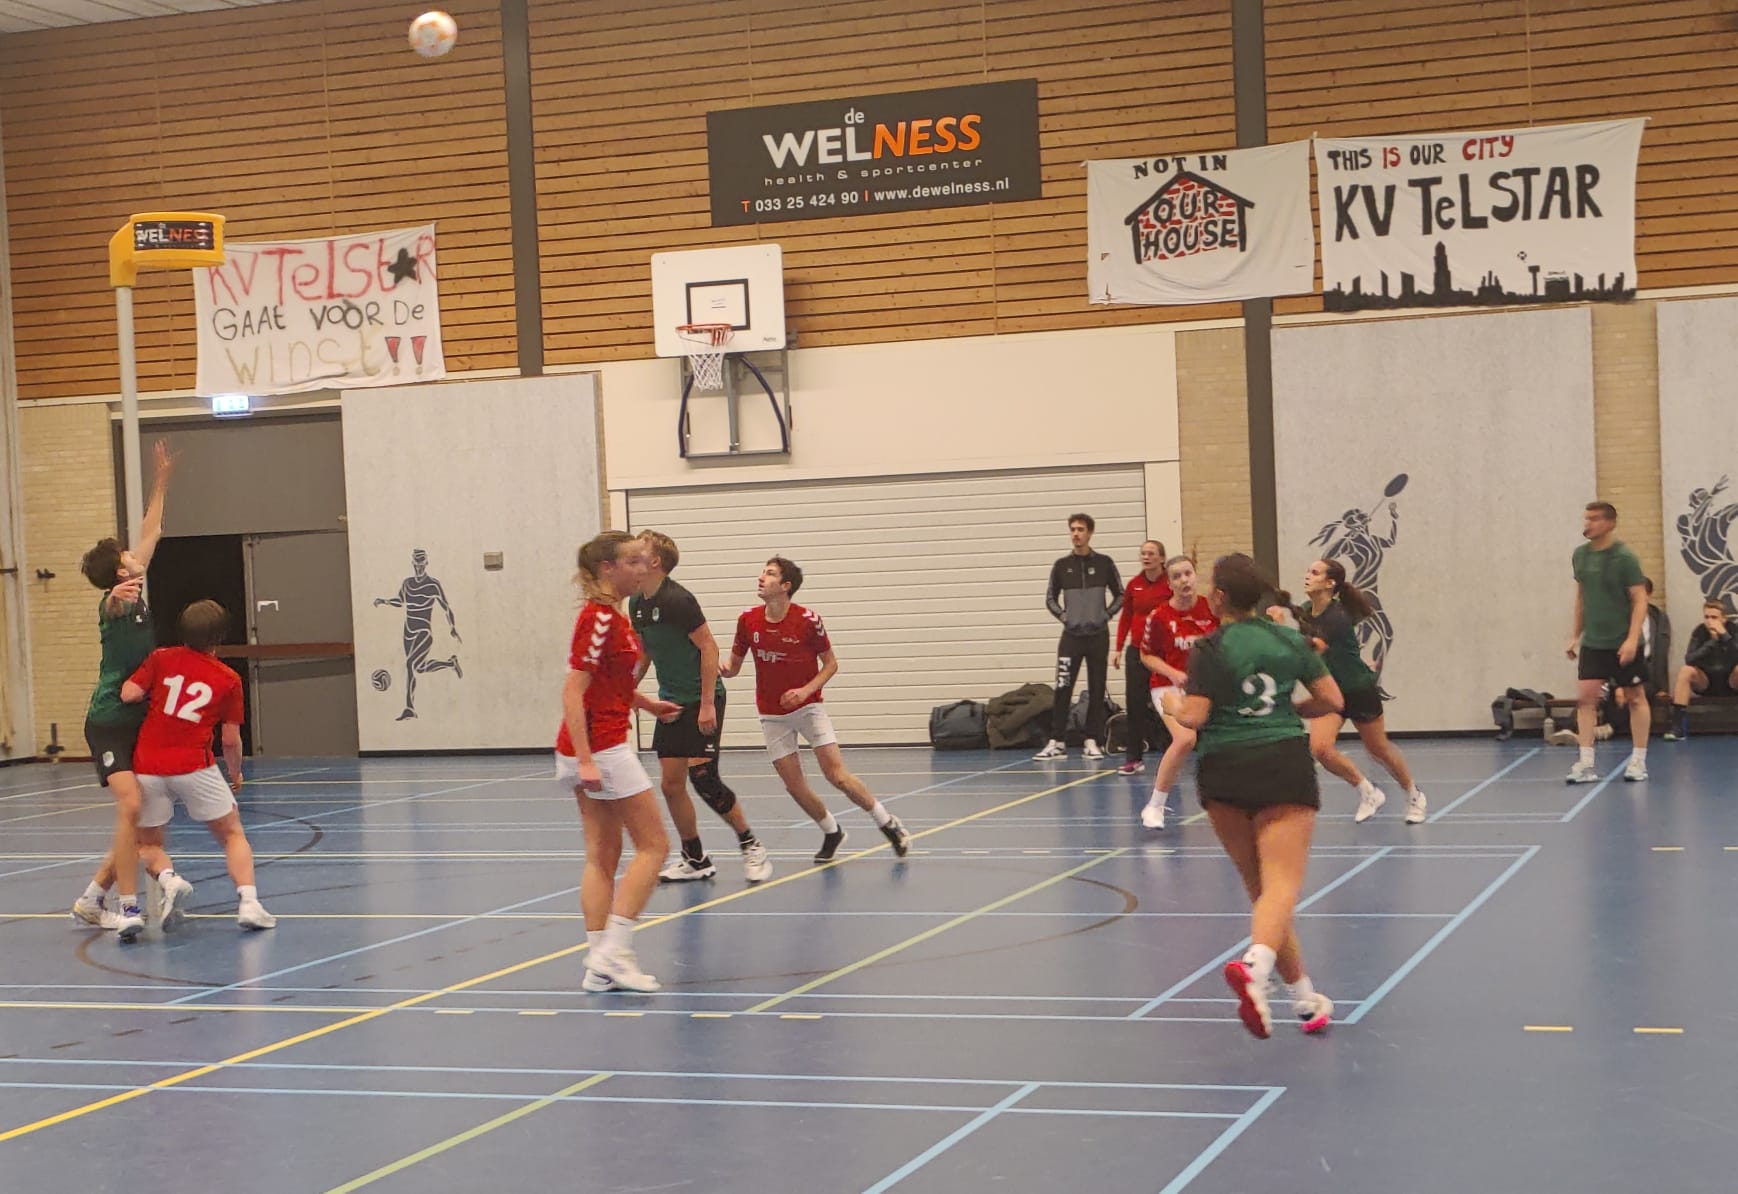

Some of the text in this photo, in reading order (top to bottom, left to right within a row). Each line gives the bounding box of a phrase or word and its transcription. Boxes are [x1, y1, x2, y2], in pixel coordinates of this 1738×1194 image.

[844, 107, 865, 125] de
[762, 114, 982, 169] WELNESS
[1327, 135, 1515, 171] THIS IS OUR CITY
[764, 158, 983, 186] health & sportcenter
[1133, 155, 1227, 180] NOT IN
[740, 200, 750, 213] T
[755, 198, 782, 212] 033
[786, 196, 804, 210] 25
[809, 193, 835, 207] 424
[840, 191, 859, 204] 90
[874, 177, 1009, 201] www.dewelness.nl
[1153, 189, 1221, 224] OUR
[1333, 164, 1603, 242] KV TeLSTAR
[1143, 218, 1238, 259] HOUSE
[163, 674, 213, 724] 12
